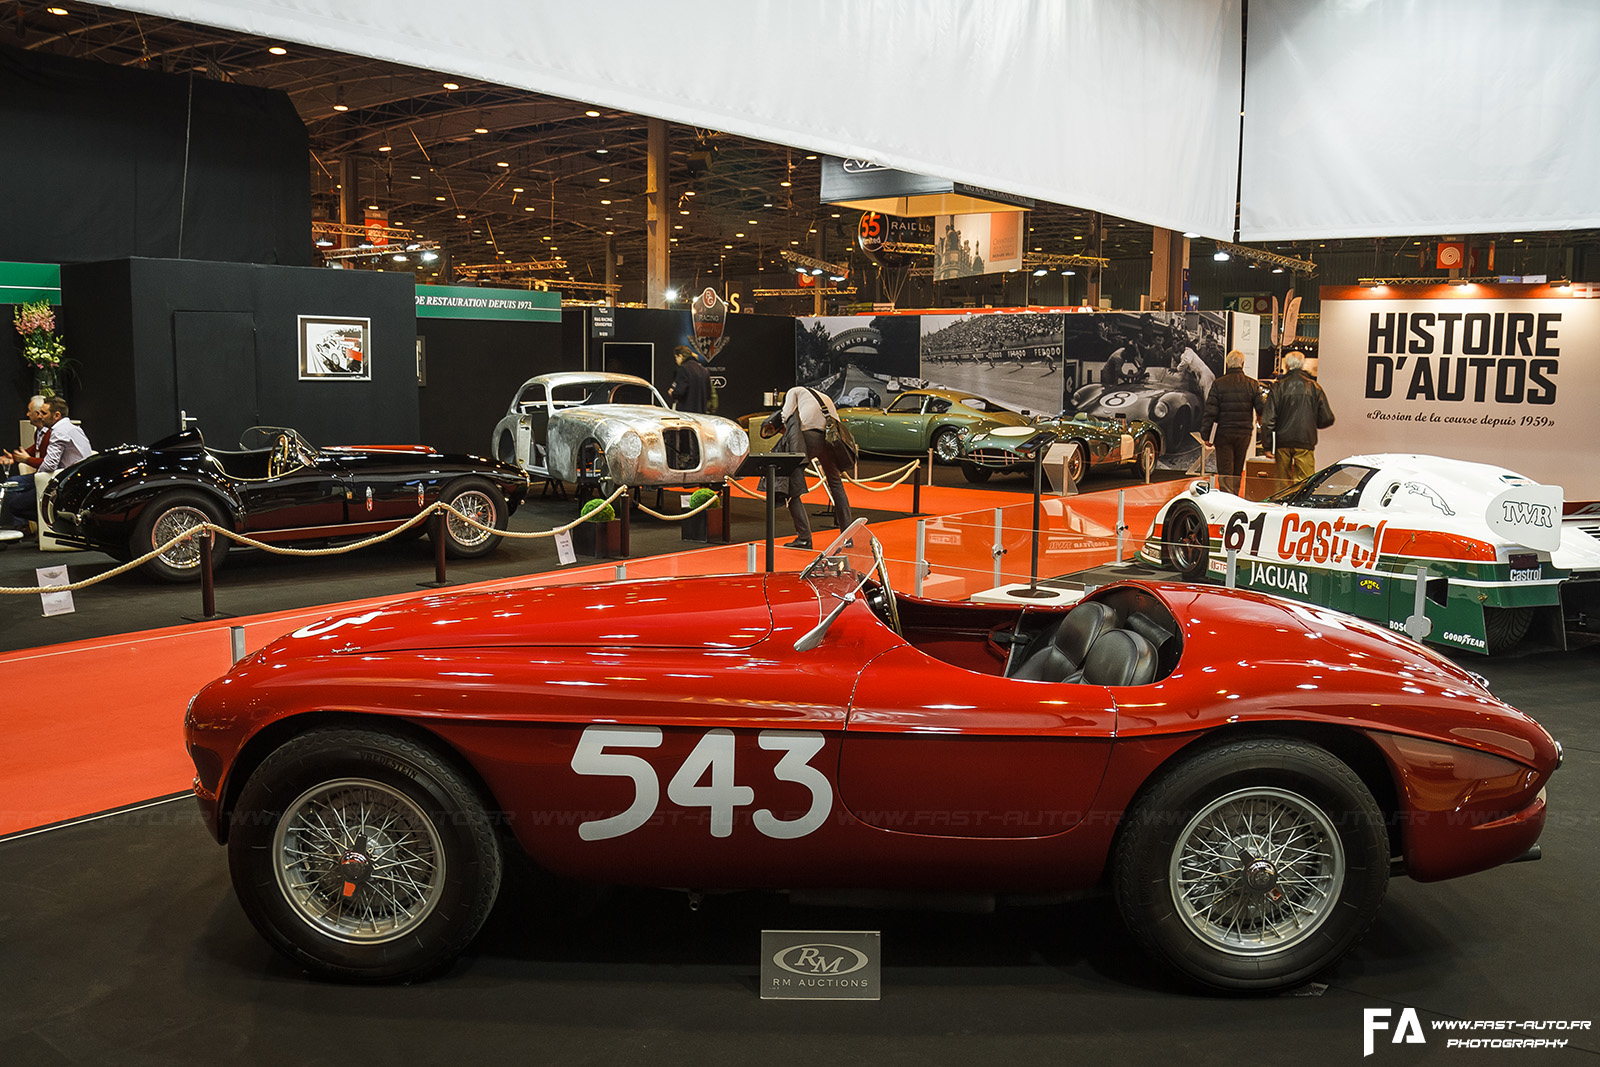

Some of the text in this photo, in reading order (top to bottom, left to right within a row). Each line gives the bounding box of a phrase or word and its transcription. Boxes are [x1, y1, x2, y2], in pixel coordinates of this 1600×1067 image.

[861, 214, 881, 239] 55
[426, 296, 487, 308] RESTAURATION
[488, 299, 516, 309] DEPUIS
[517, 301, 532, 309] 1973
[835, 336, 867, 351] DUNLOP
[1368, 312, 1562, 357] HISTOIRE
[1365, 356, 1559, 405] D'AUTOS
[1105, 392, 1131, 407] 8
[1414, 411, 1427, 422] de
[1430, 412, 1441, 423] la
[1444, 415, 1477, 424] course
[1480, 413, 1516, 428] depuis
[1502, 500, 1553, 528] TWR
[1224, 511, 1267, 556] 61
[1277, 513, 1388, 570] Castrol
[1249, 561, 1309, 595] JAGUAR
[1509, 564, 1542, 581] Castrol
[1443, 631, 1486, 649] GOODYEAR
[570, 724, 834, 842] 543
[772, 978, 868, 987] RM AUCTIONS
